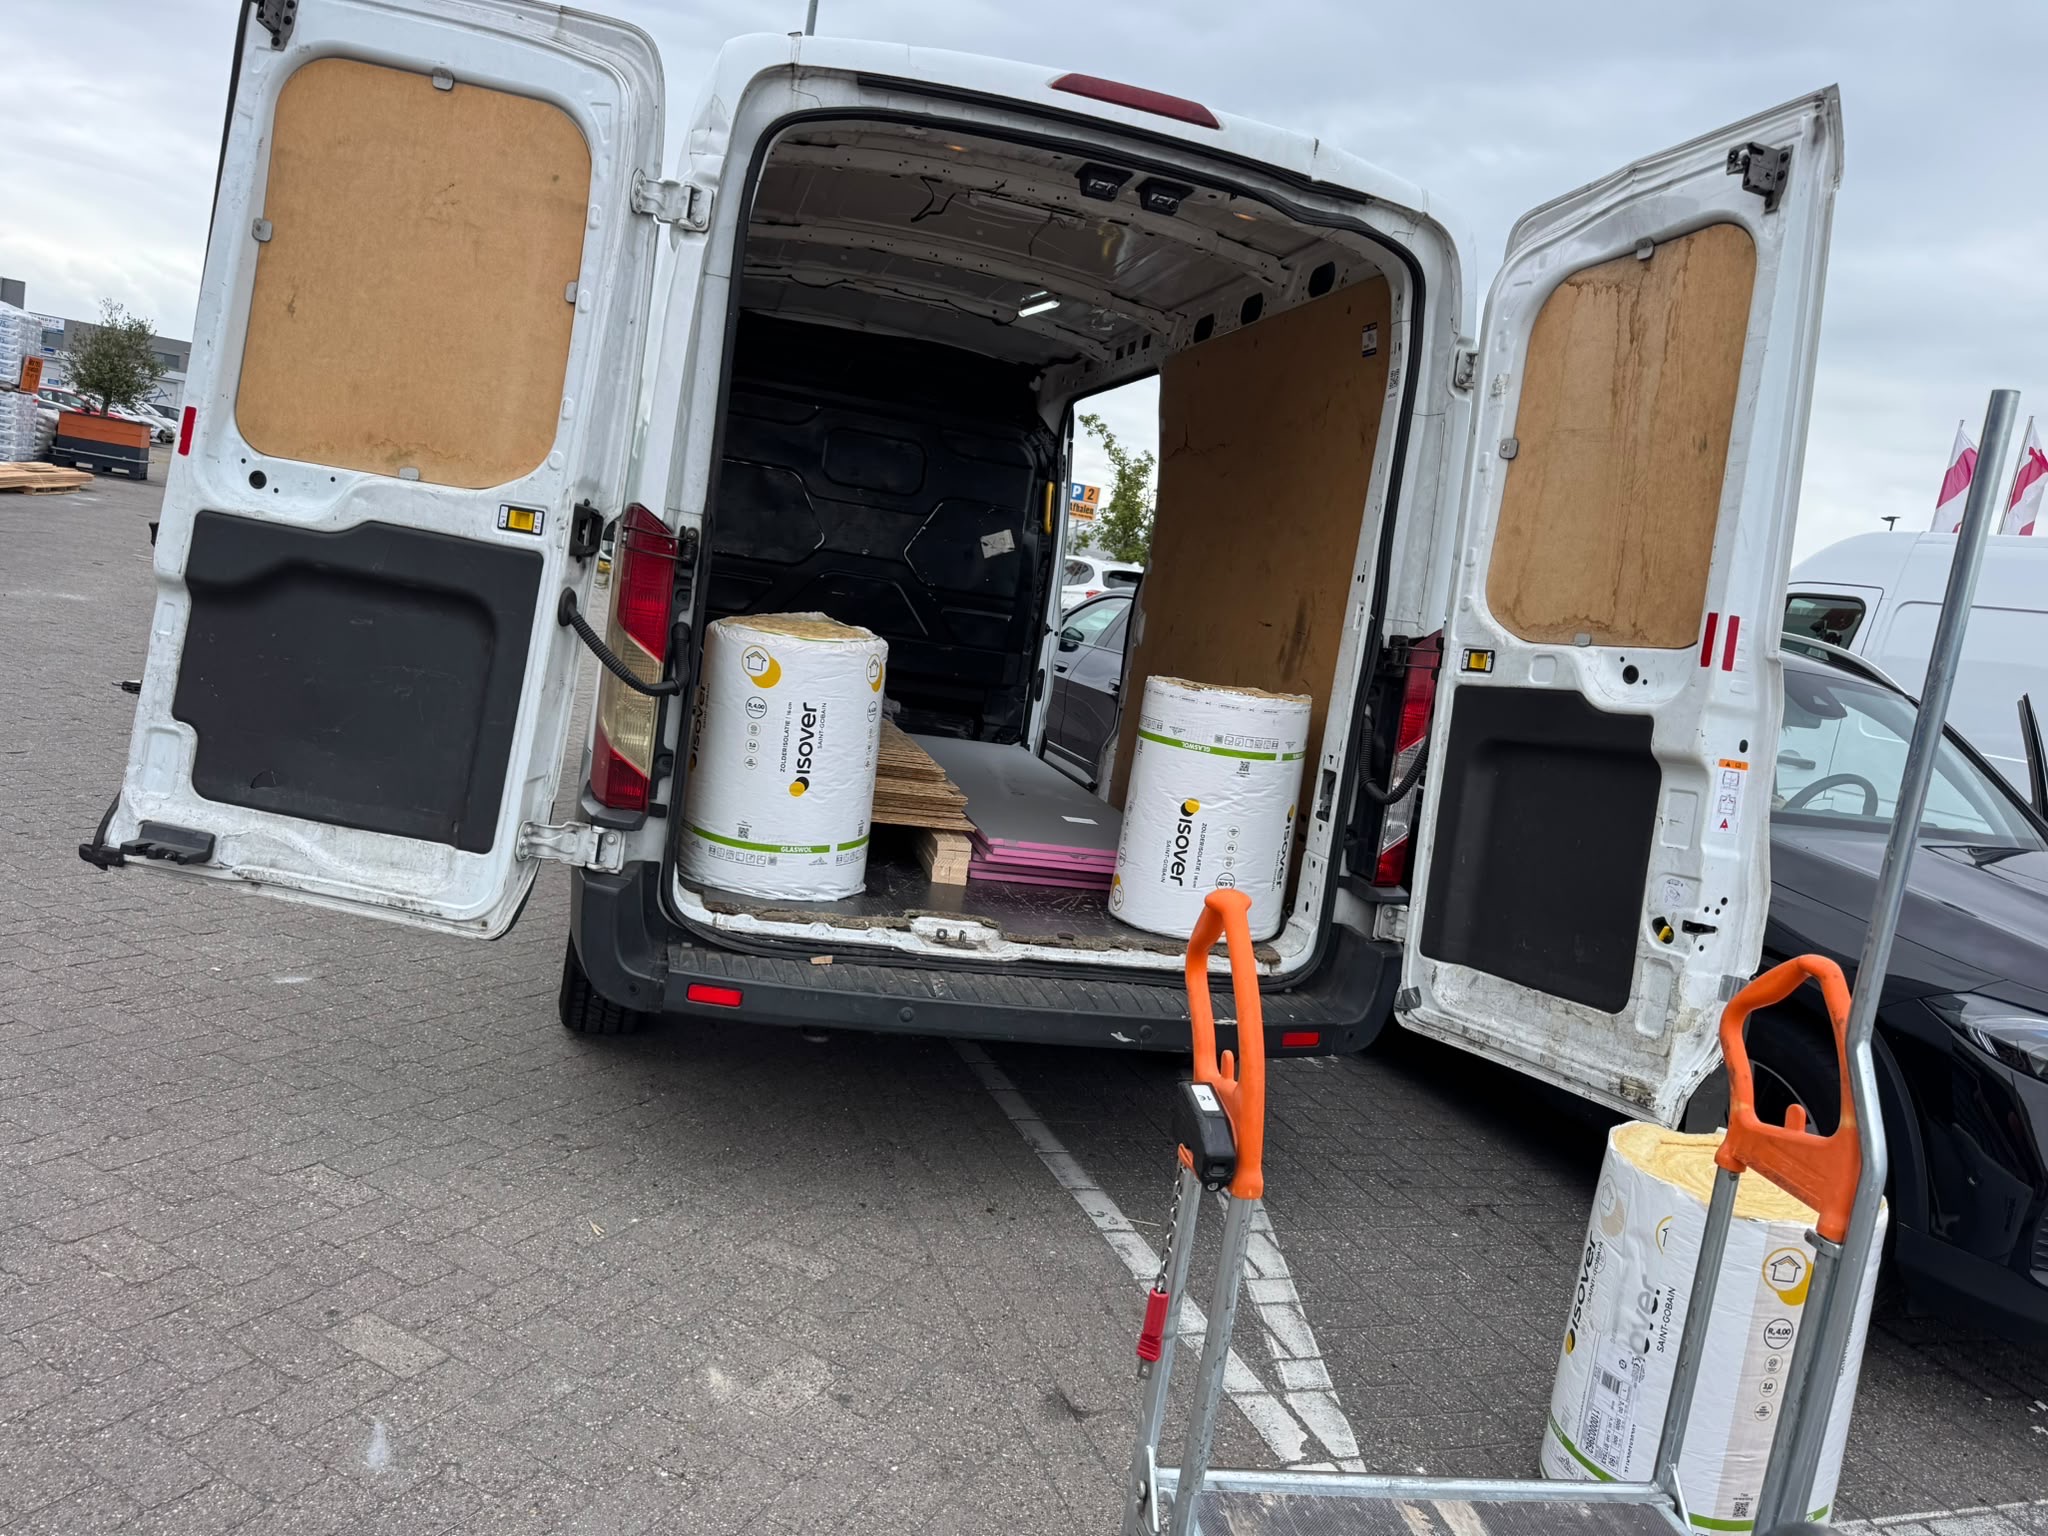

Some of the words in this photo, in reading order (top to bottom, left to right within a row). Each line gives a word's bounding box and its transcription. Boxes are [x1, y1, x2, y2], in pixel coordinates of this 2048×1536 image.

[1072, 485, 1081, 497] P
[1087, 488, 1094, 500] 2
[780, 721, 790, 773] ZOLDERISOLATIE
[796, 702, 817, 774] isover
[817, 703, 827, 749] SAINT-GOBAIN
[1181, 741, 1211, 753] GLASWOL
[1161, 840, 1171, 883] SAINT-GOBAIN
[1170, 818, 1192, 886] isover
[1195, 822, 1207, 871] ZOLDERISOLATIE
[1572, 1231, 1596, 1330] isover
[1657, 1287, 1676, 1353] SAINT-GOBAIN
